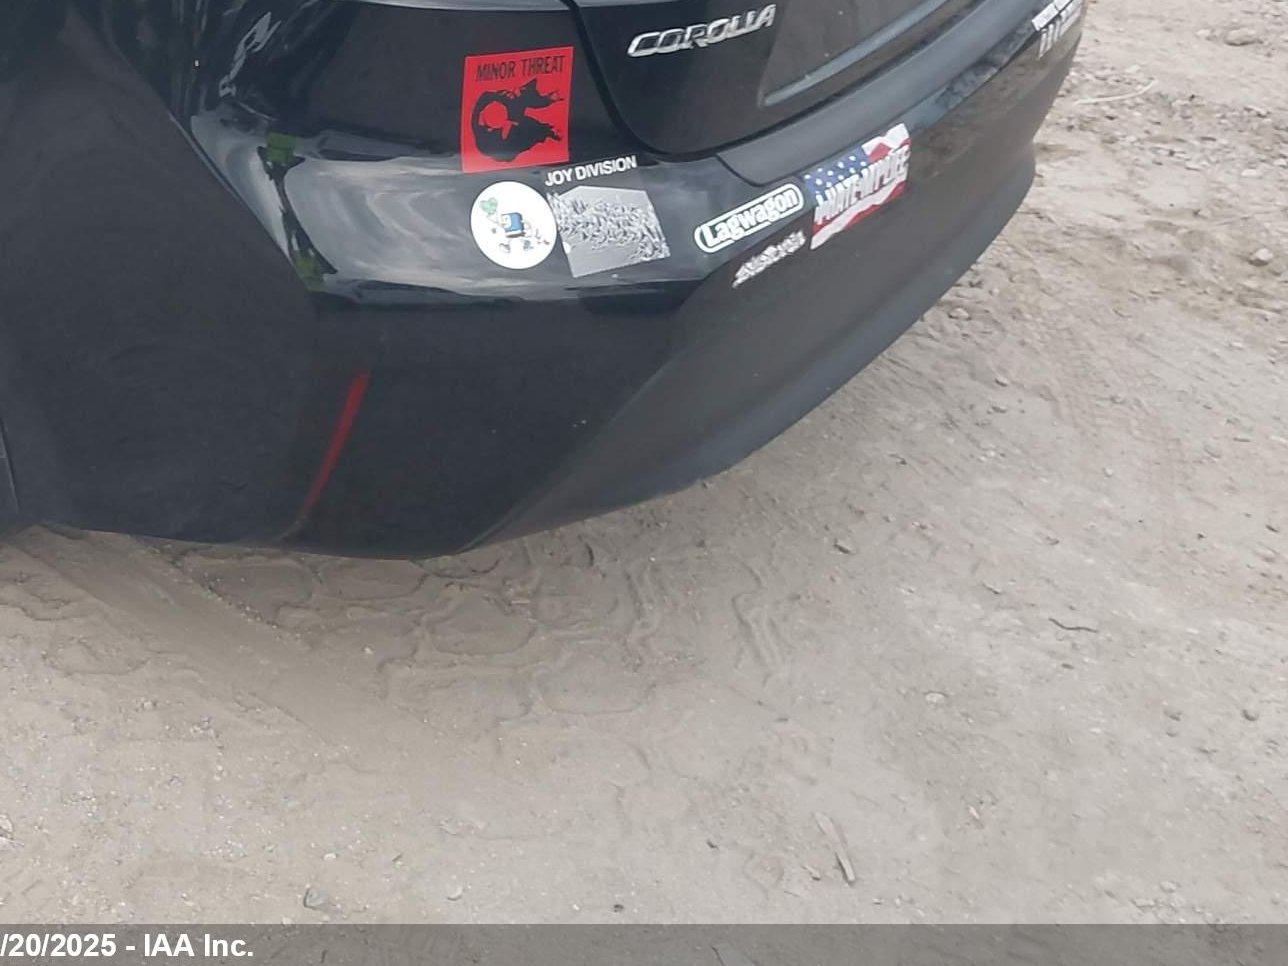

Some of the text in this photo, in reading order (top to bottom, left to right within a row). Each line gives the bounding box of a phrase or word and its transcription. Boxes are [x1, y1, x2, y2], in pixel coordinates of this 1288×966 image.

[627, 3, 776, 57] COROLLA
[476, 55, 565, 82] MINOR THREAT
[545, 155, 637, 187] JOY DIVISION
[700, 189, 799, 248] Lagwagon
